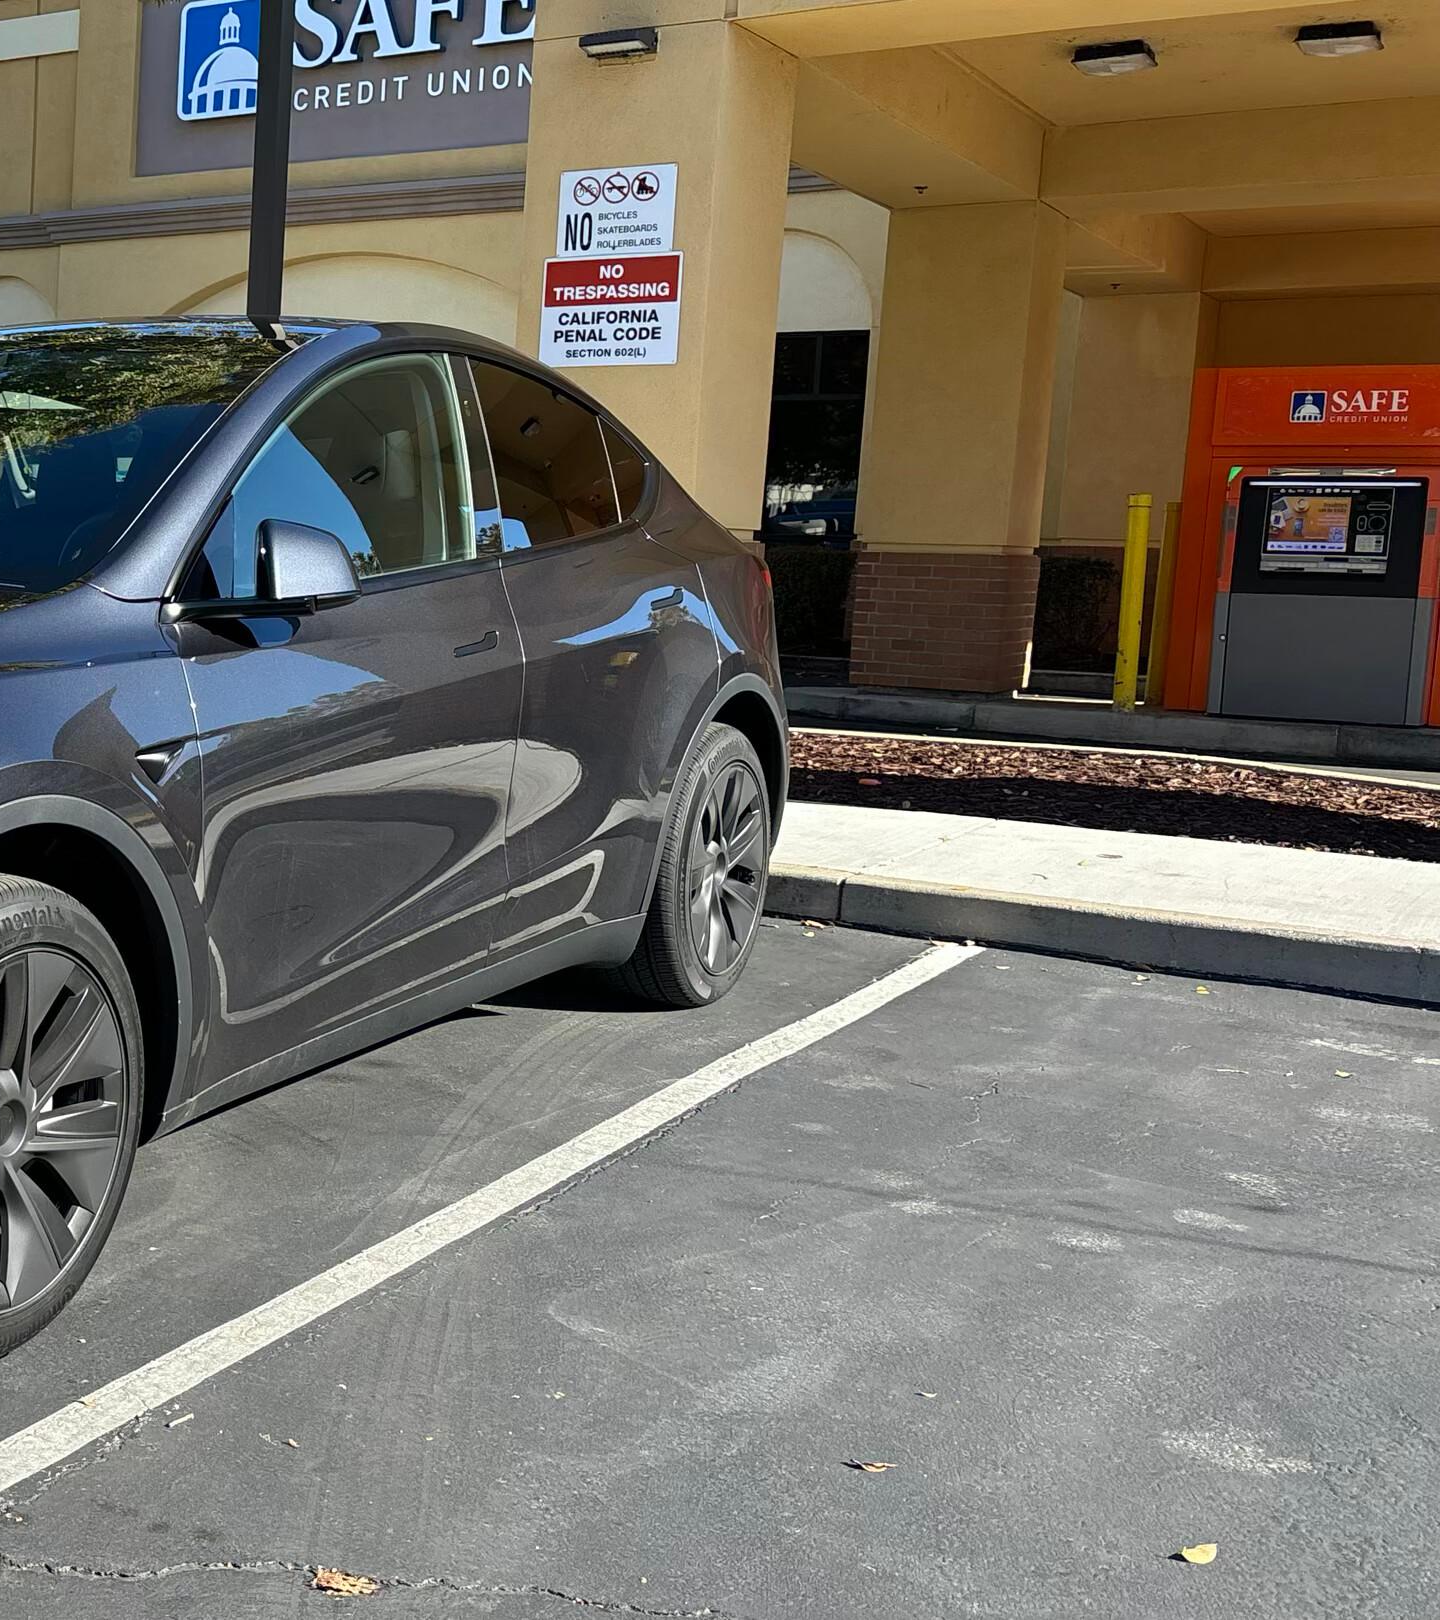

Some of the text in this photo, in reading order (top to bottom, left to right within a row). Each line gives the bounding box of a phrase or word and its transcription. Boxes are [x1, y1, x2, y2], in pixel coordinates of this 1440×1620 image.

[293, 63, 534, 111] CREDIT UNION
[598, 211, 638, 221] BICYCLES
[564, 212, 593, 251] NO
[597, 224, 658, 235] SKATEBOARDS
[596, 237, 662, 249] ROLLERBLADES
[599, 264, 624, 280] NO
[553, 282, 670, 301] TRESPASSING
[558, 309, 659, 326] CALIFORNIA
[553, 327, 662, 343] PENAL CODE
[565, 347, 647, 359] SECTION 602(L)
[1331, 390, 1409, 412] SAFE
[1329, 415, 1408, 423] CREDIT UNION
